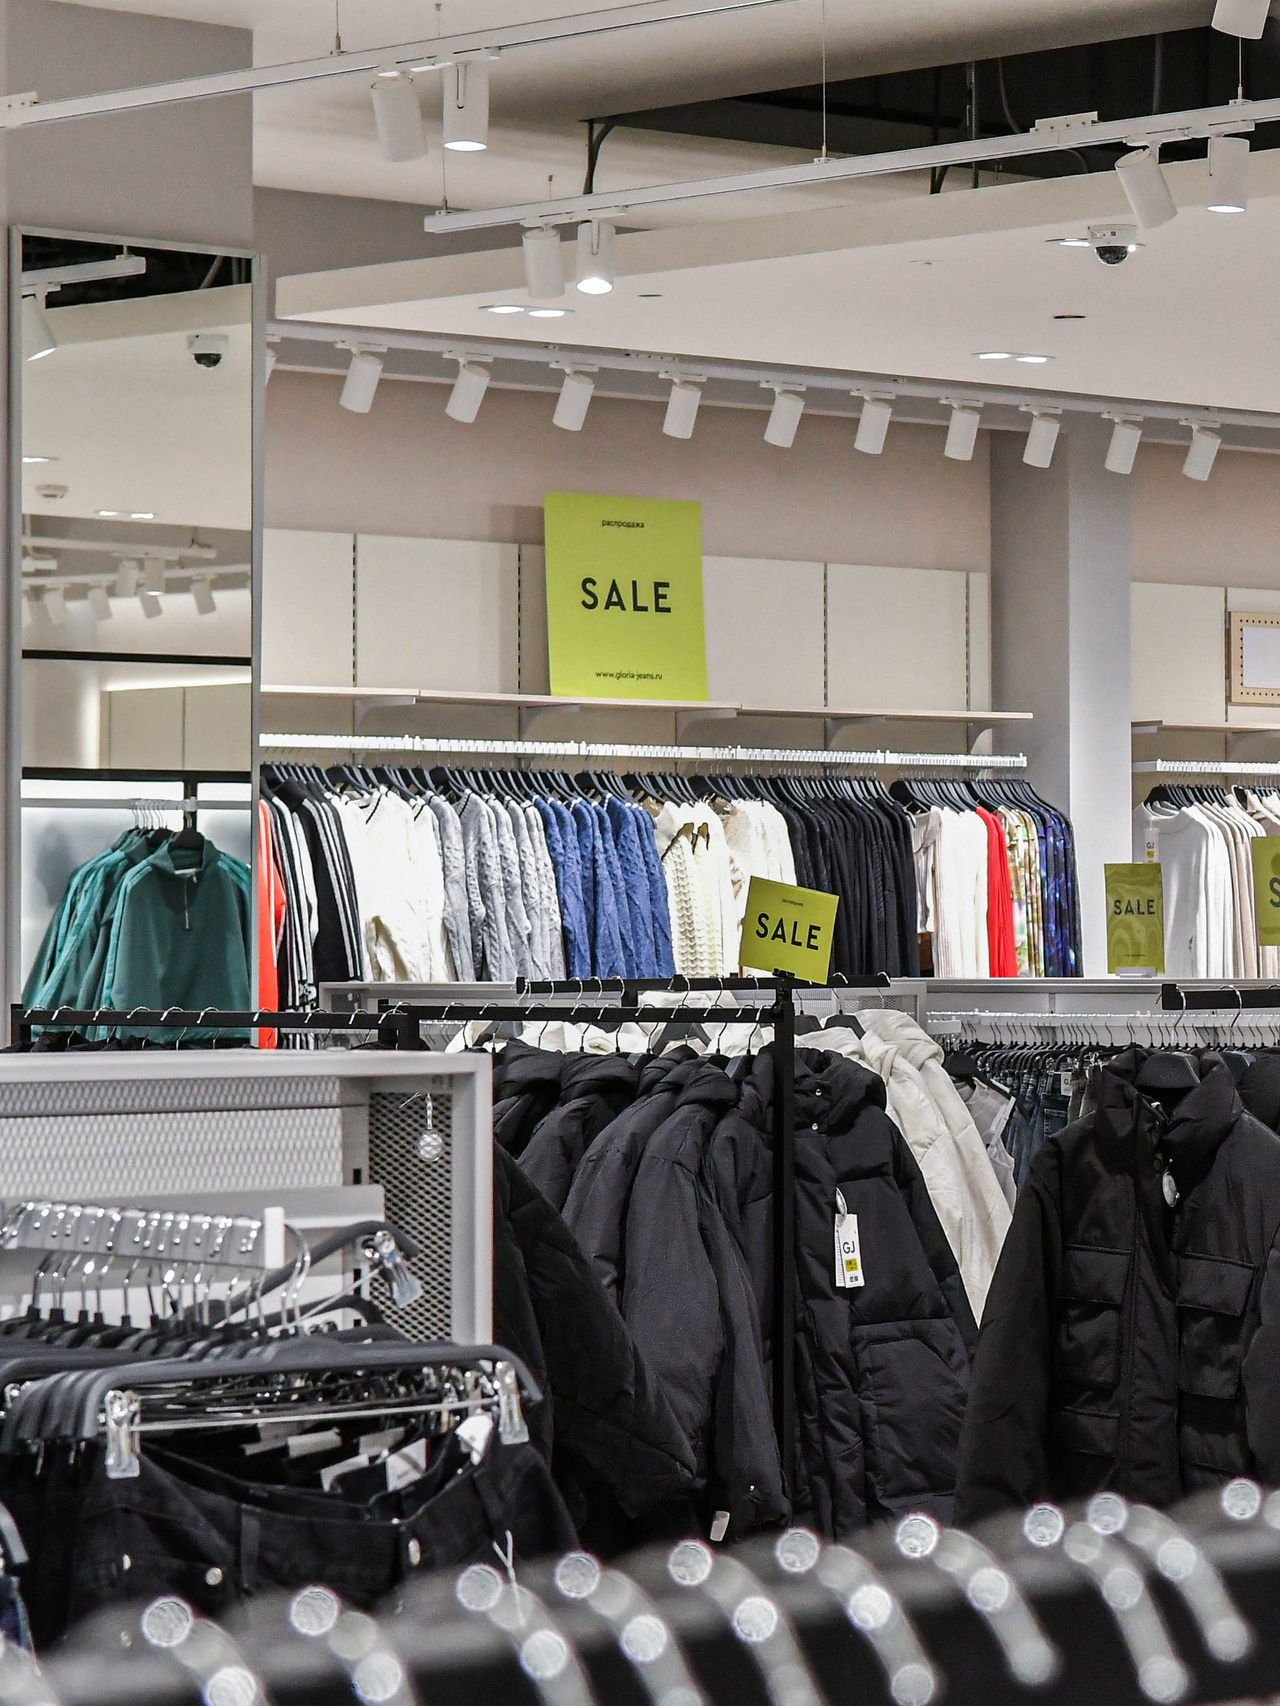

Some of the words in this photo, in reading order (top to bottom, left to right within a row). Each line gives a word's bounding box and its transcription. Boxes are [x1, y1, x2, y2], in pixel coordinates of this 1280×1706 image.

[581, 577, 672, 613] SALE
[595, 670, 663, 681] www.gloria-jeans.ru
[1113, 898, 1156, 916] SALE
[755, 912, 821, 951] SALE
[842, 1240, 856, 1254] GJ
